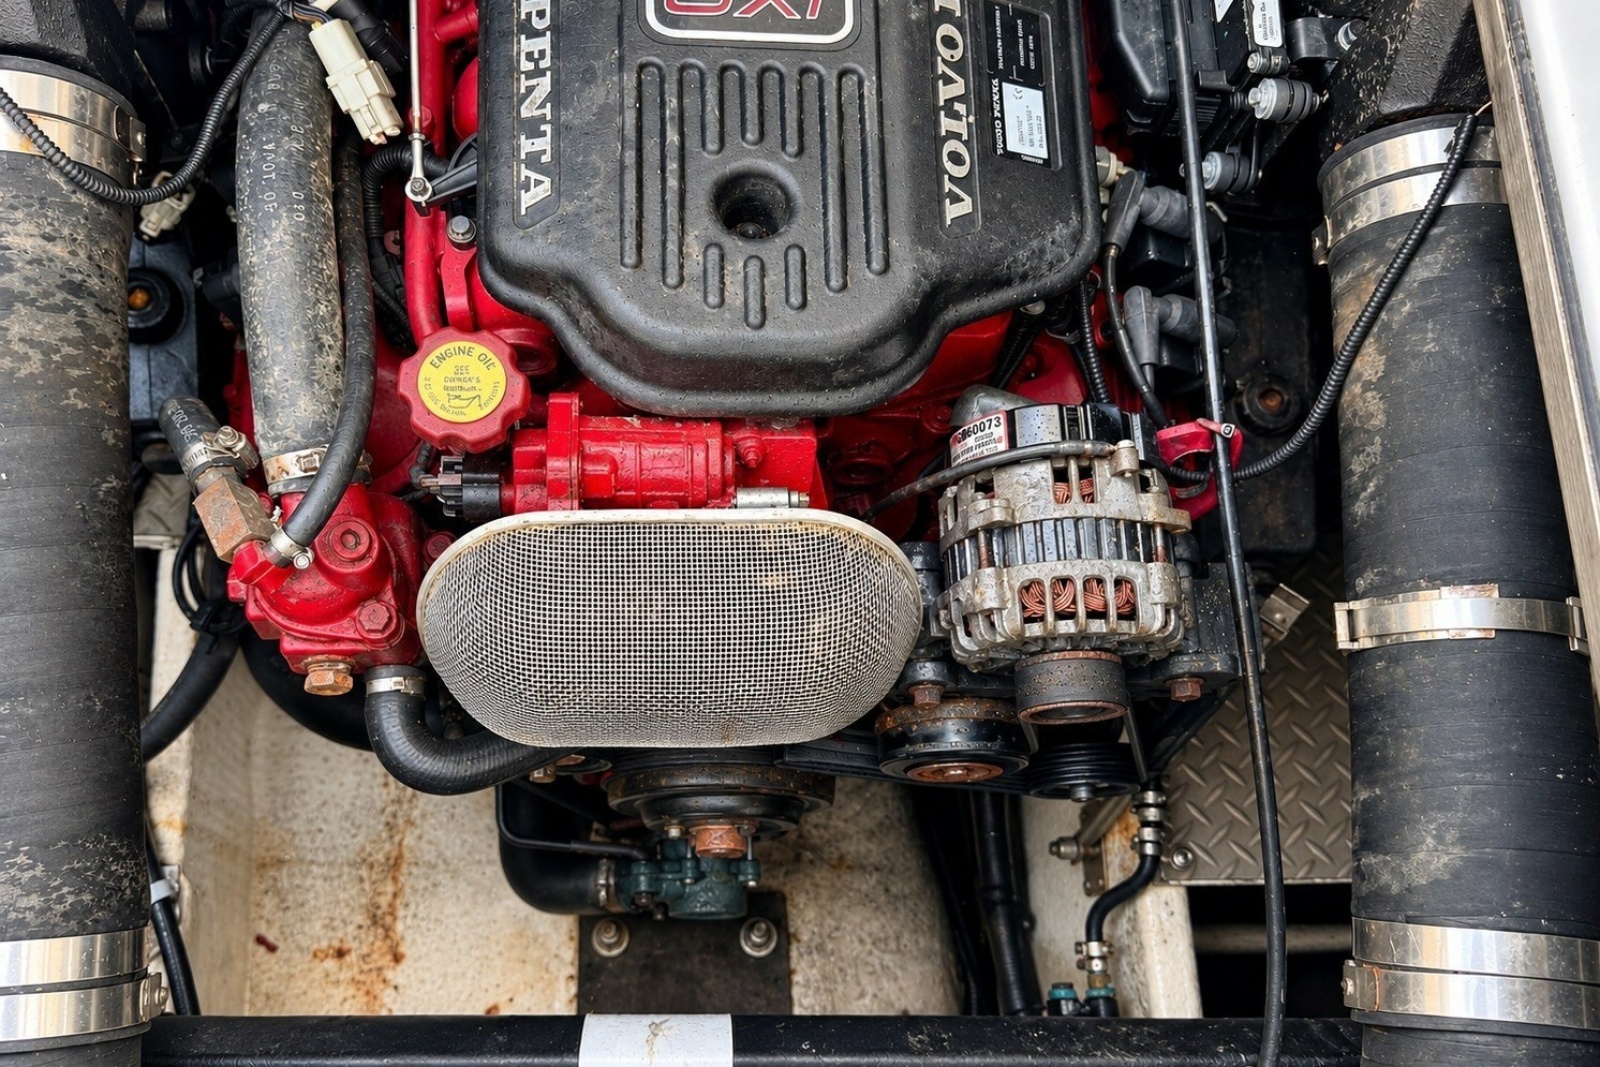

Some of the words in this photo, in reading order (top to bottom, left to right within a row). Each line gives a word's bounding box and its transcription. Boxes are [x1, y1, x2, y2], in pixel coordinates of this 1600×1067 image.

[519, 0, 552, 216] PENTA
[934, 22, 973, 228] VOLVO
[429, 345, 475, 370] ENGINE
